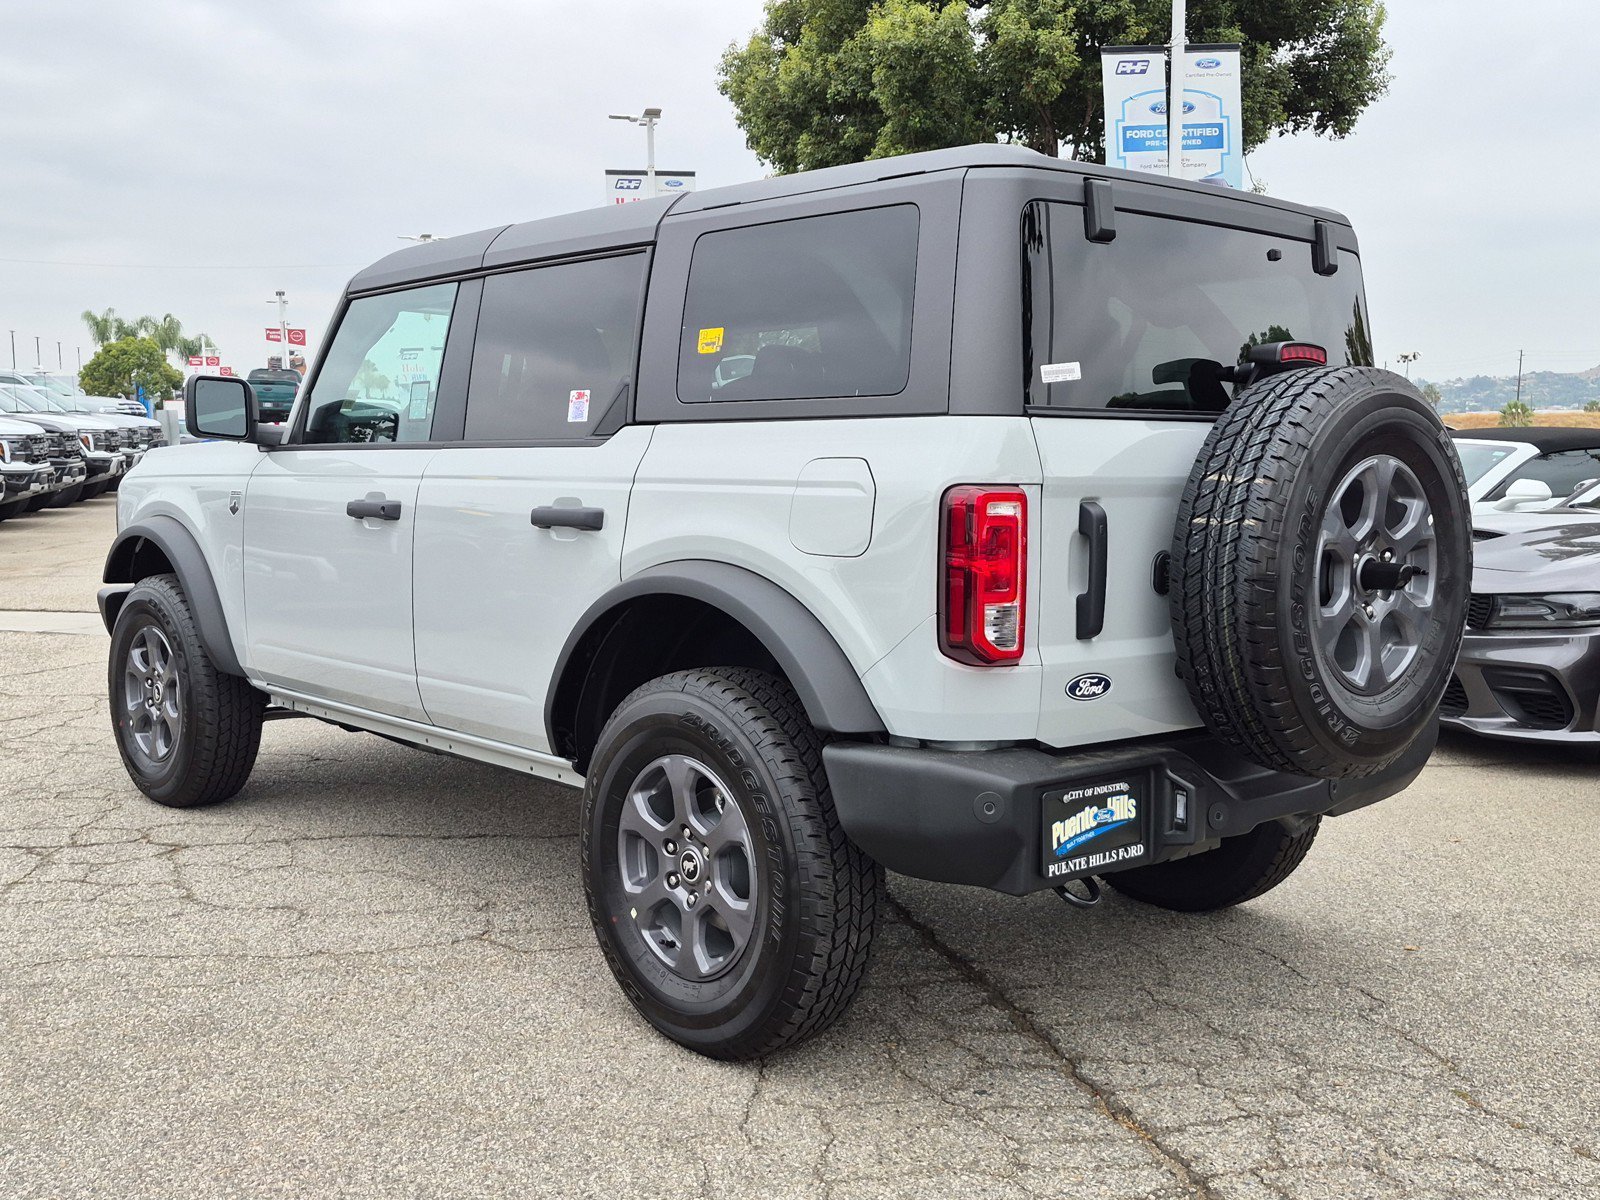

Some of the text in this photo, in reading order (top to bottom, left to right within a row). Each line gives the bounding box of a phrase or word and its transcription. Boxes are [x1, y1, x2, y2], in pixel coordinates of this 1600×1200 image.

[1116, 61, 1149, 74] PHF
[1126, 129, 1154, 139] FORD
[575, 391, 585, 400] 3M
[1289, 485, 1361, 746] BRIDGESTONE
[1075, 678, 1105, 696] Ford
[1068, 782, 1124, 800] CITY OF INDUSTRY
[1052, 805, 1099, 850] Puente
[1107, 794, 1137, 822] Hills
[679, 711, 787, 953] BRIDGESTONE
[1048, 844, 1144, 877] PUENTE HILLS FORD
